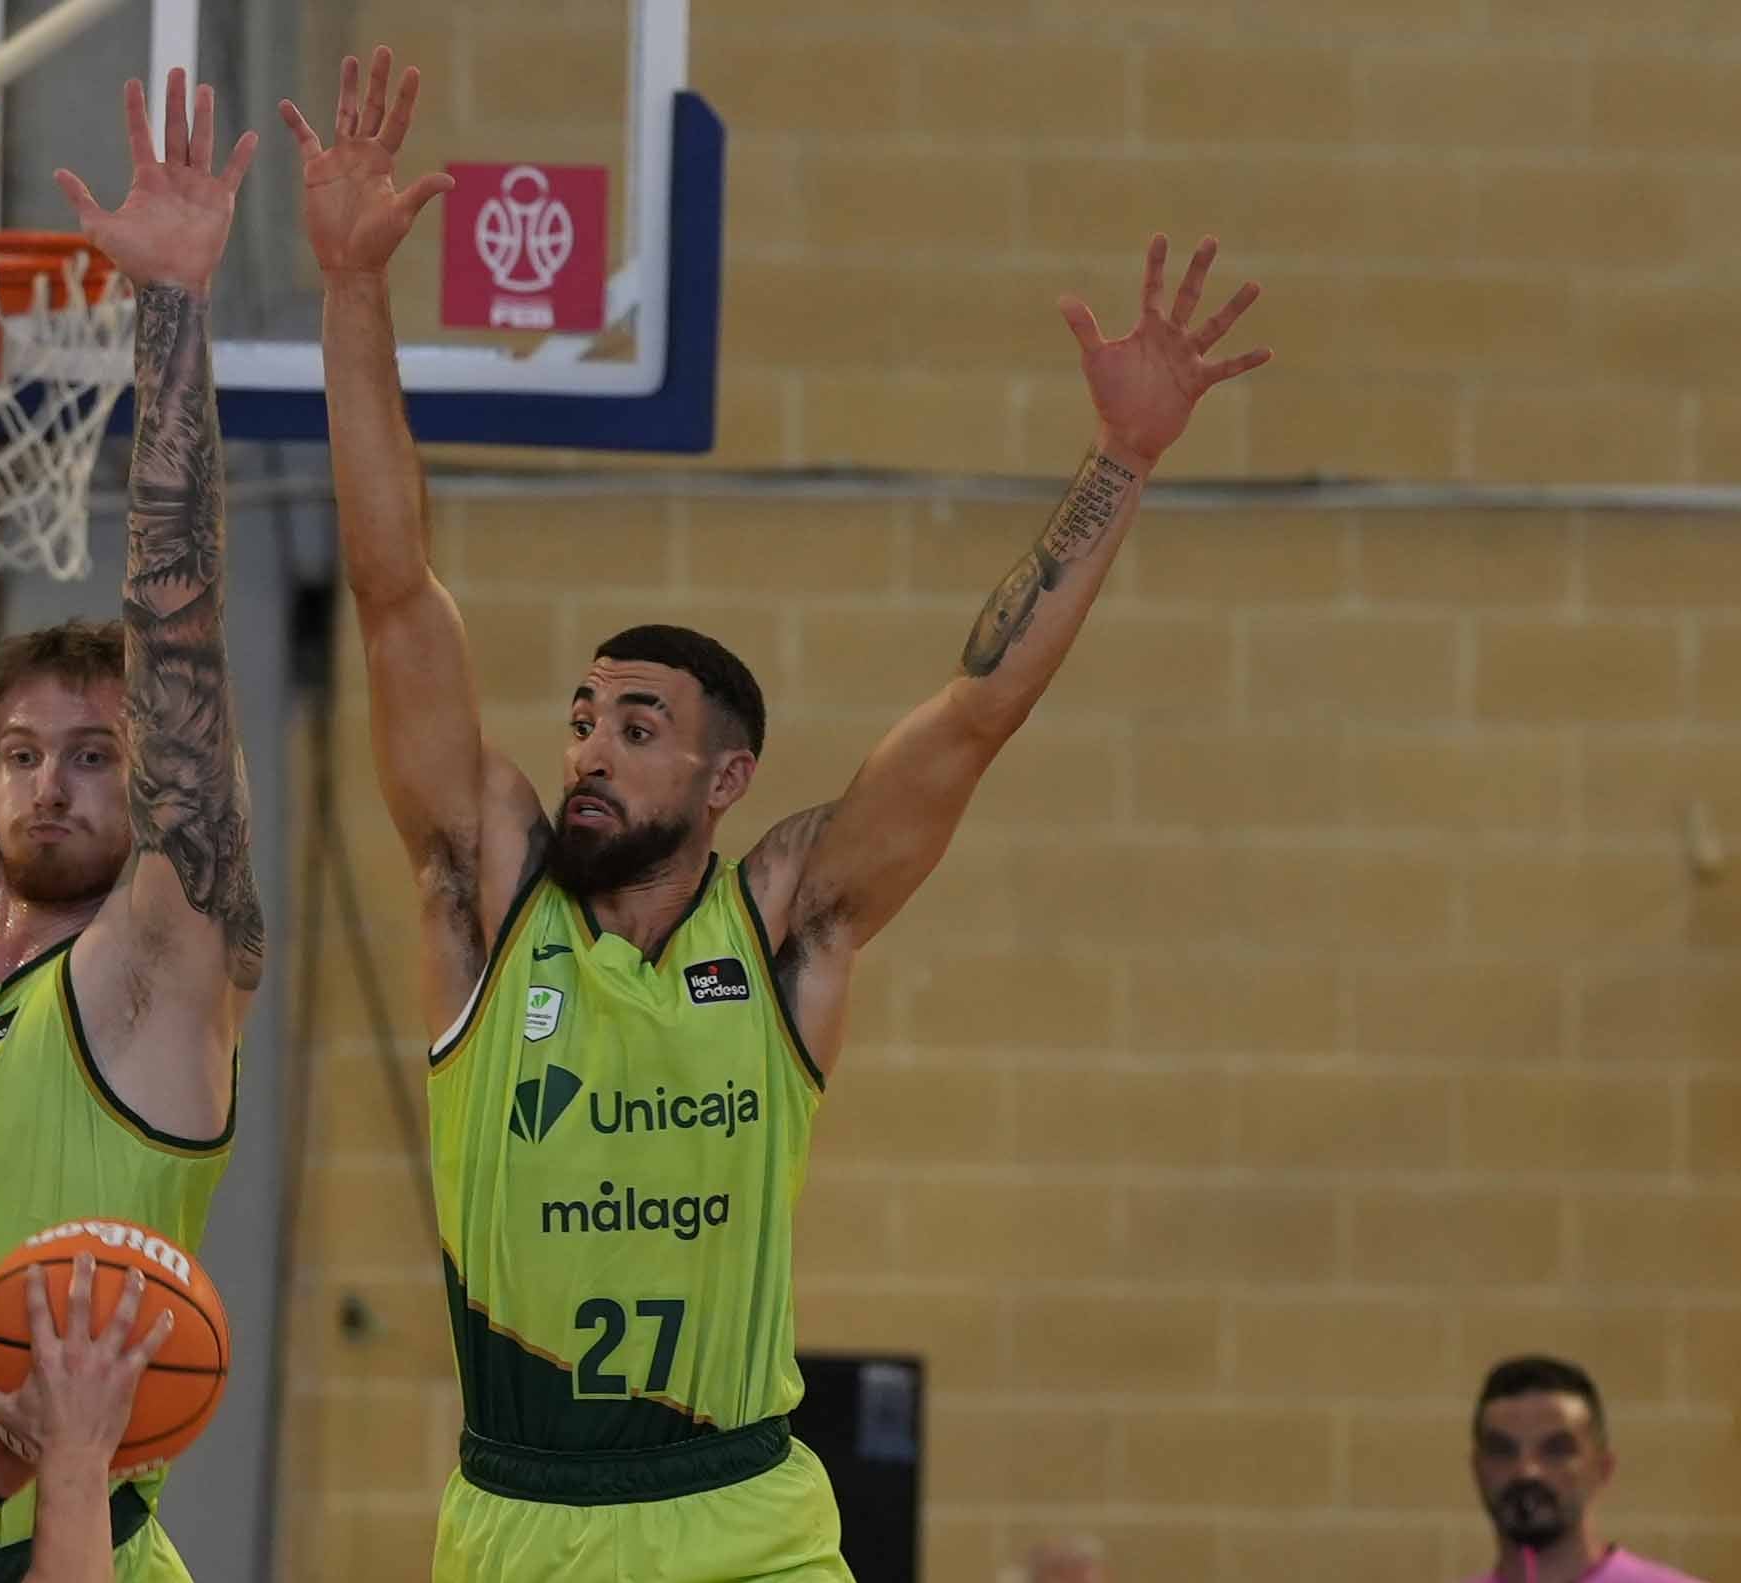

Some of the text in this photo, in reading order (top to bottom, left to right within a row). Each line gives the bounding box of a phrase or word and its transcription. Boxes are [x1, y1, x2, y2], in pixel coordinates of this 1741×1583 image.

[690, 974, 718, 989] liga
[694, 983, 748, 1000] endesa
[589, 1081, 760, 1138] Unicaja
[573, 1298, 686, 1395] 27
